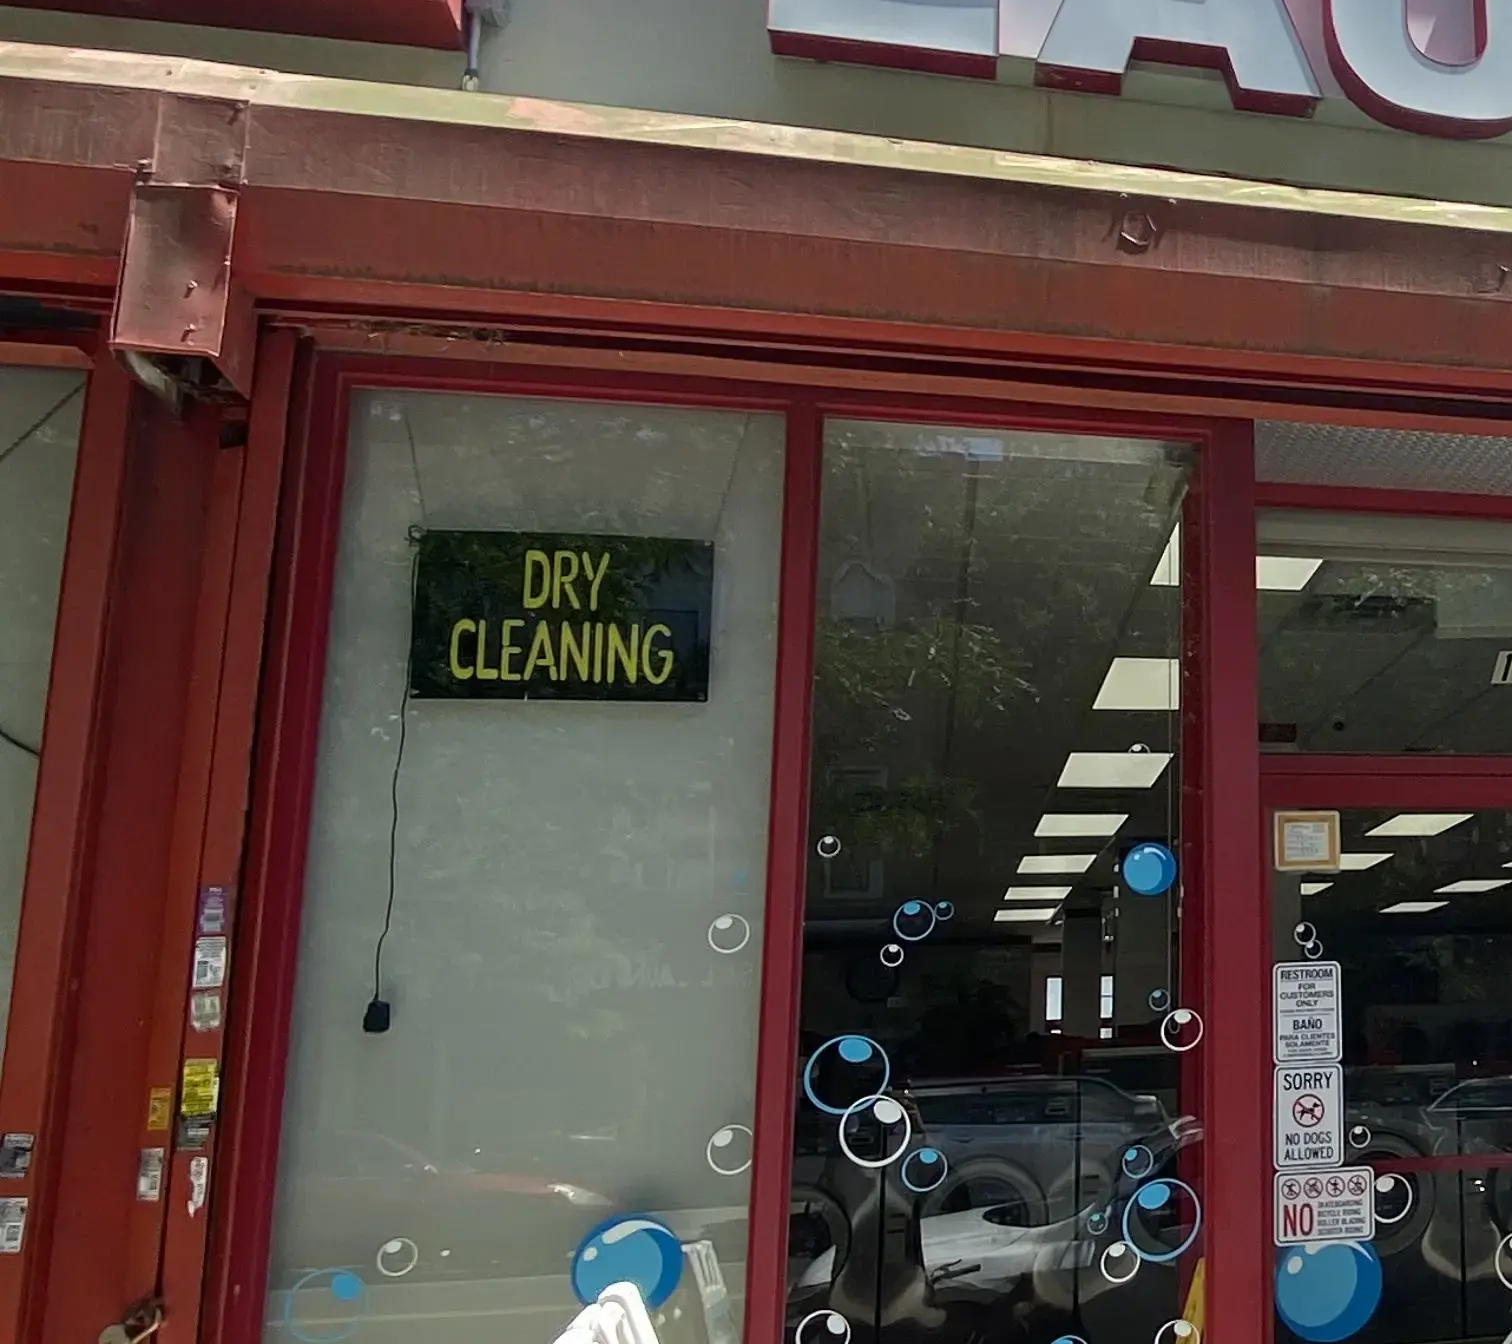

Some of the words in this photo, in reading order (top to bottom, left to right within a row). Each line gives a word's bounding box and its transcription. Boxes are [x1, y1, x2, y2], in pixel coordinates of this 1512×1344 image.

[522, 549, 611, 612] DRY
[450, 617, 674, 685] CLEANING
[1280, 968, 1333, 980] RESTROOM
[1280, 990, 1334, 1000] CUSTOMERS
[1295, 999, 1319, 1007] ONLY
[1293, 1016, 1323, 1030] BAÑO
[1283, 1071, 1333, 1091] SORRY
[1285, 1133, 1300, 1146] NO
[1304, 1131, 1333, 1145] DOGS
[1284, 1146, 1334, 1161] ALLOWED
[1283, 1203, 1314, 1237] NO
